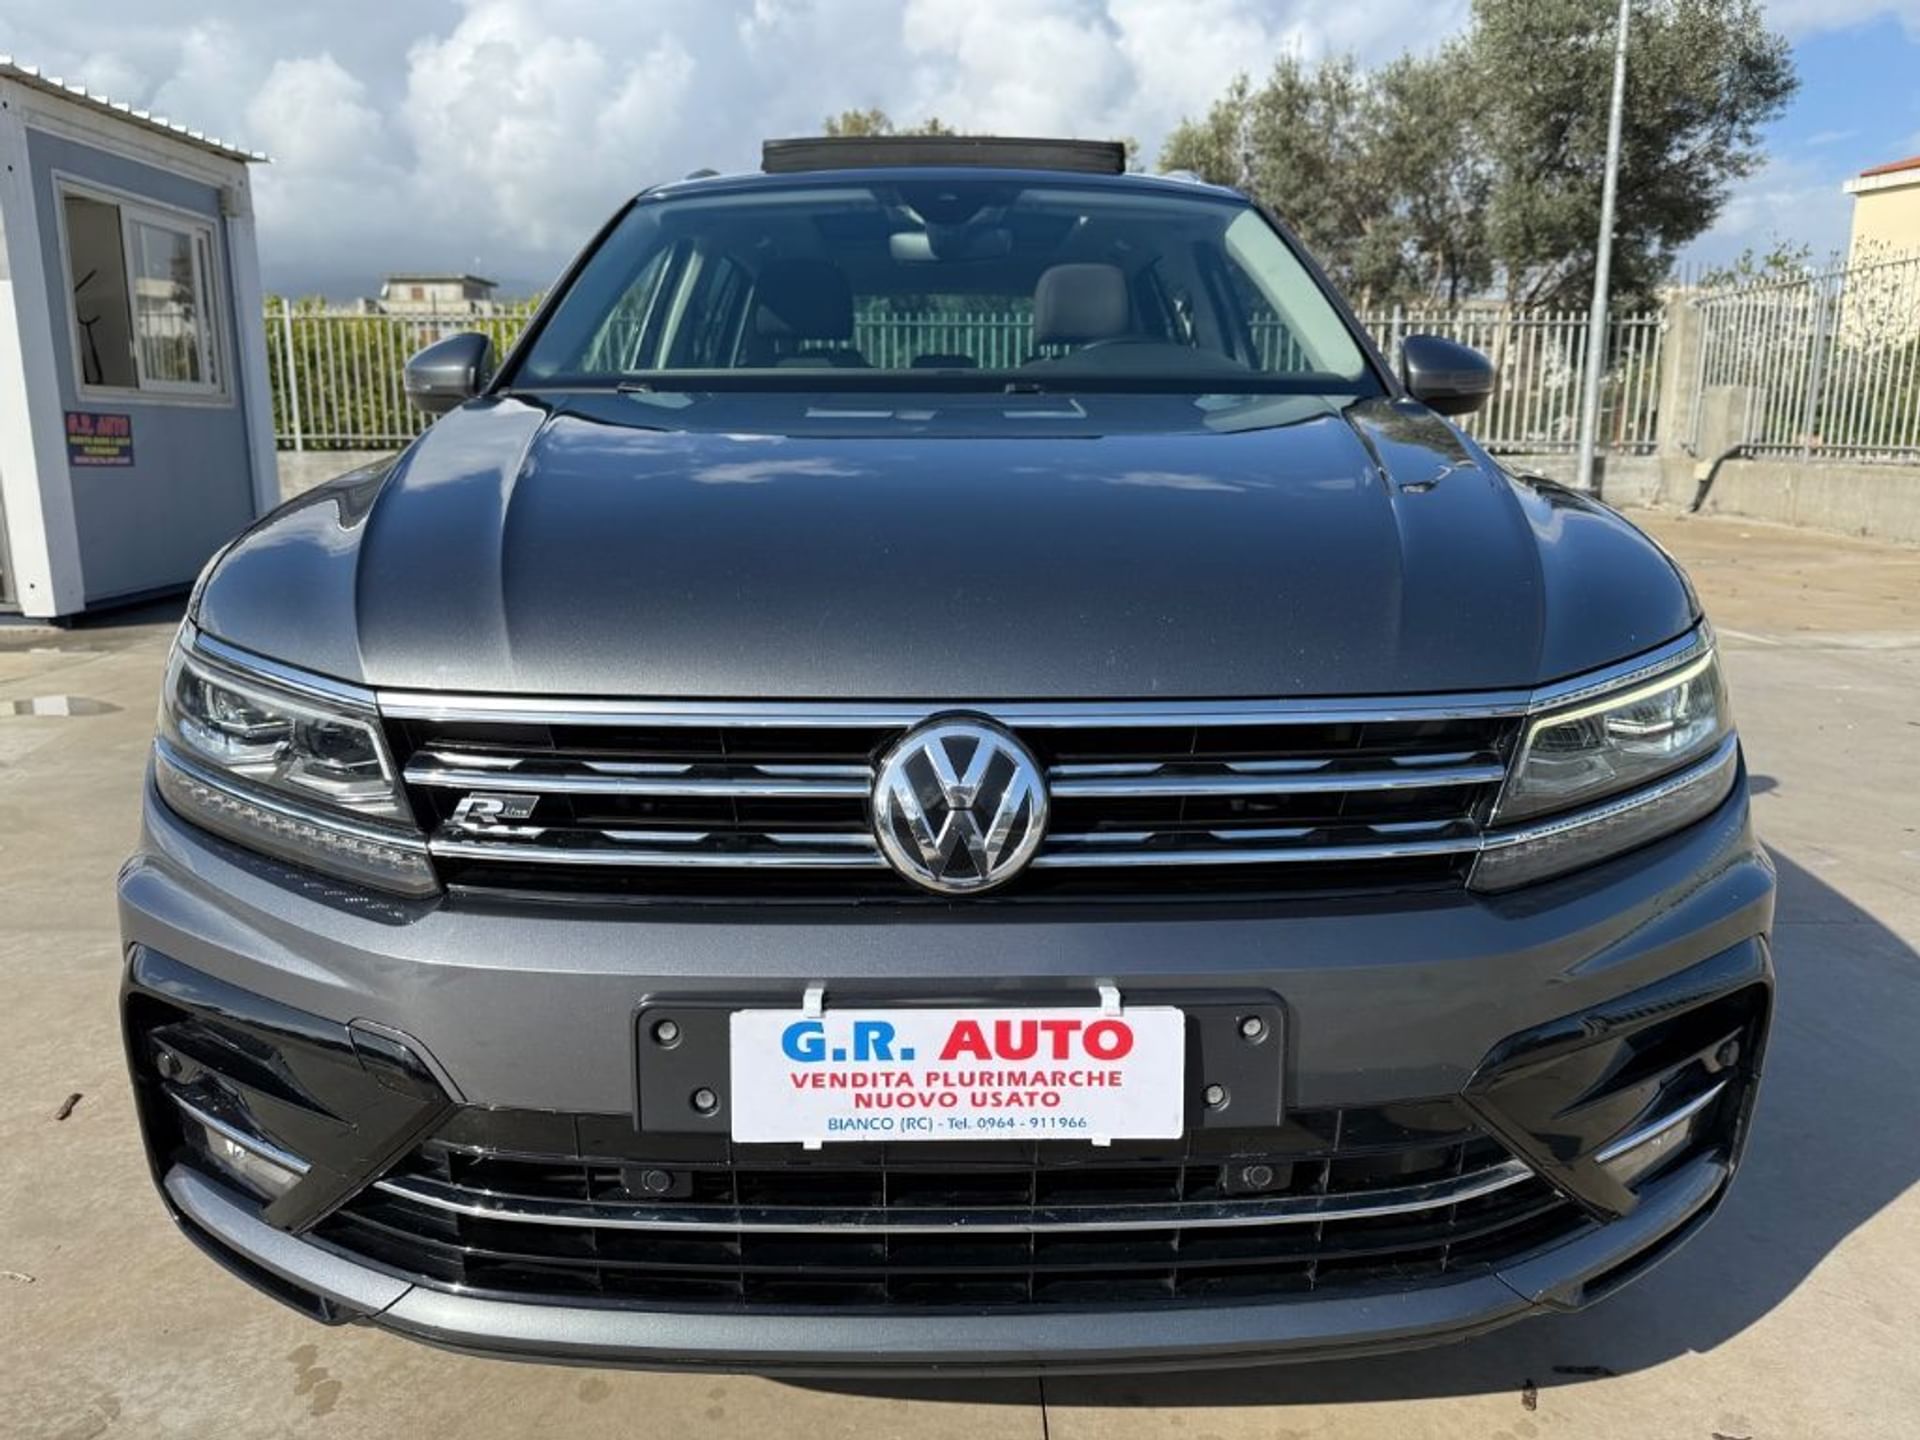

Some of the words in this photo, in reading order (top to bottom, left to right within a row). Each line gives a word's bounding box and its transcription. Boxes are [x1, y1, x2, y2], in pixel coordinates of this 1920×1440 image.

[780, 1019, 917, 1064] G.R.
[938, 1018, 1134, 1062] AUTO
[790, 1071, 914, 1089] VENDITA
[925, 1070, 1123, 1088] PLURIMARCHE
[854, 1092, 958, 1109] NUOVO
[970, 1091, 1061, 1108] USATO
[827, 1117, 895, 1132] BIANCO
[900, 1116, 934, 1132] (RC)
[947, 1117, 971, 1130] Tel.
[976, 1117, 1015, 1130] 0964
[1029, 1116, 1088, 1129] 911966
